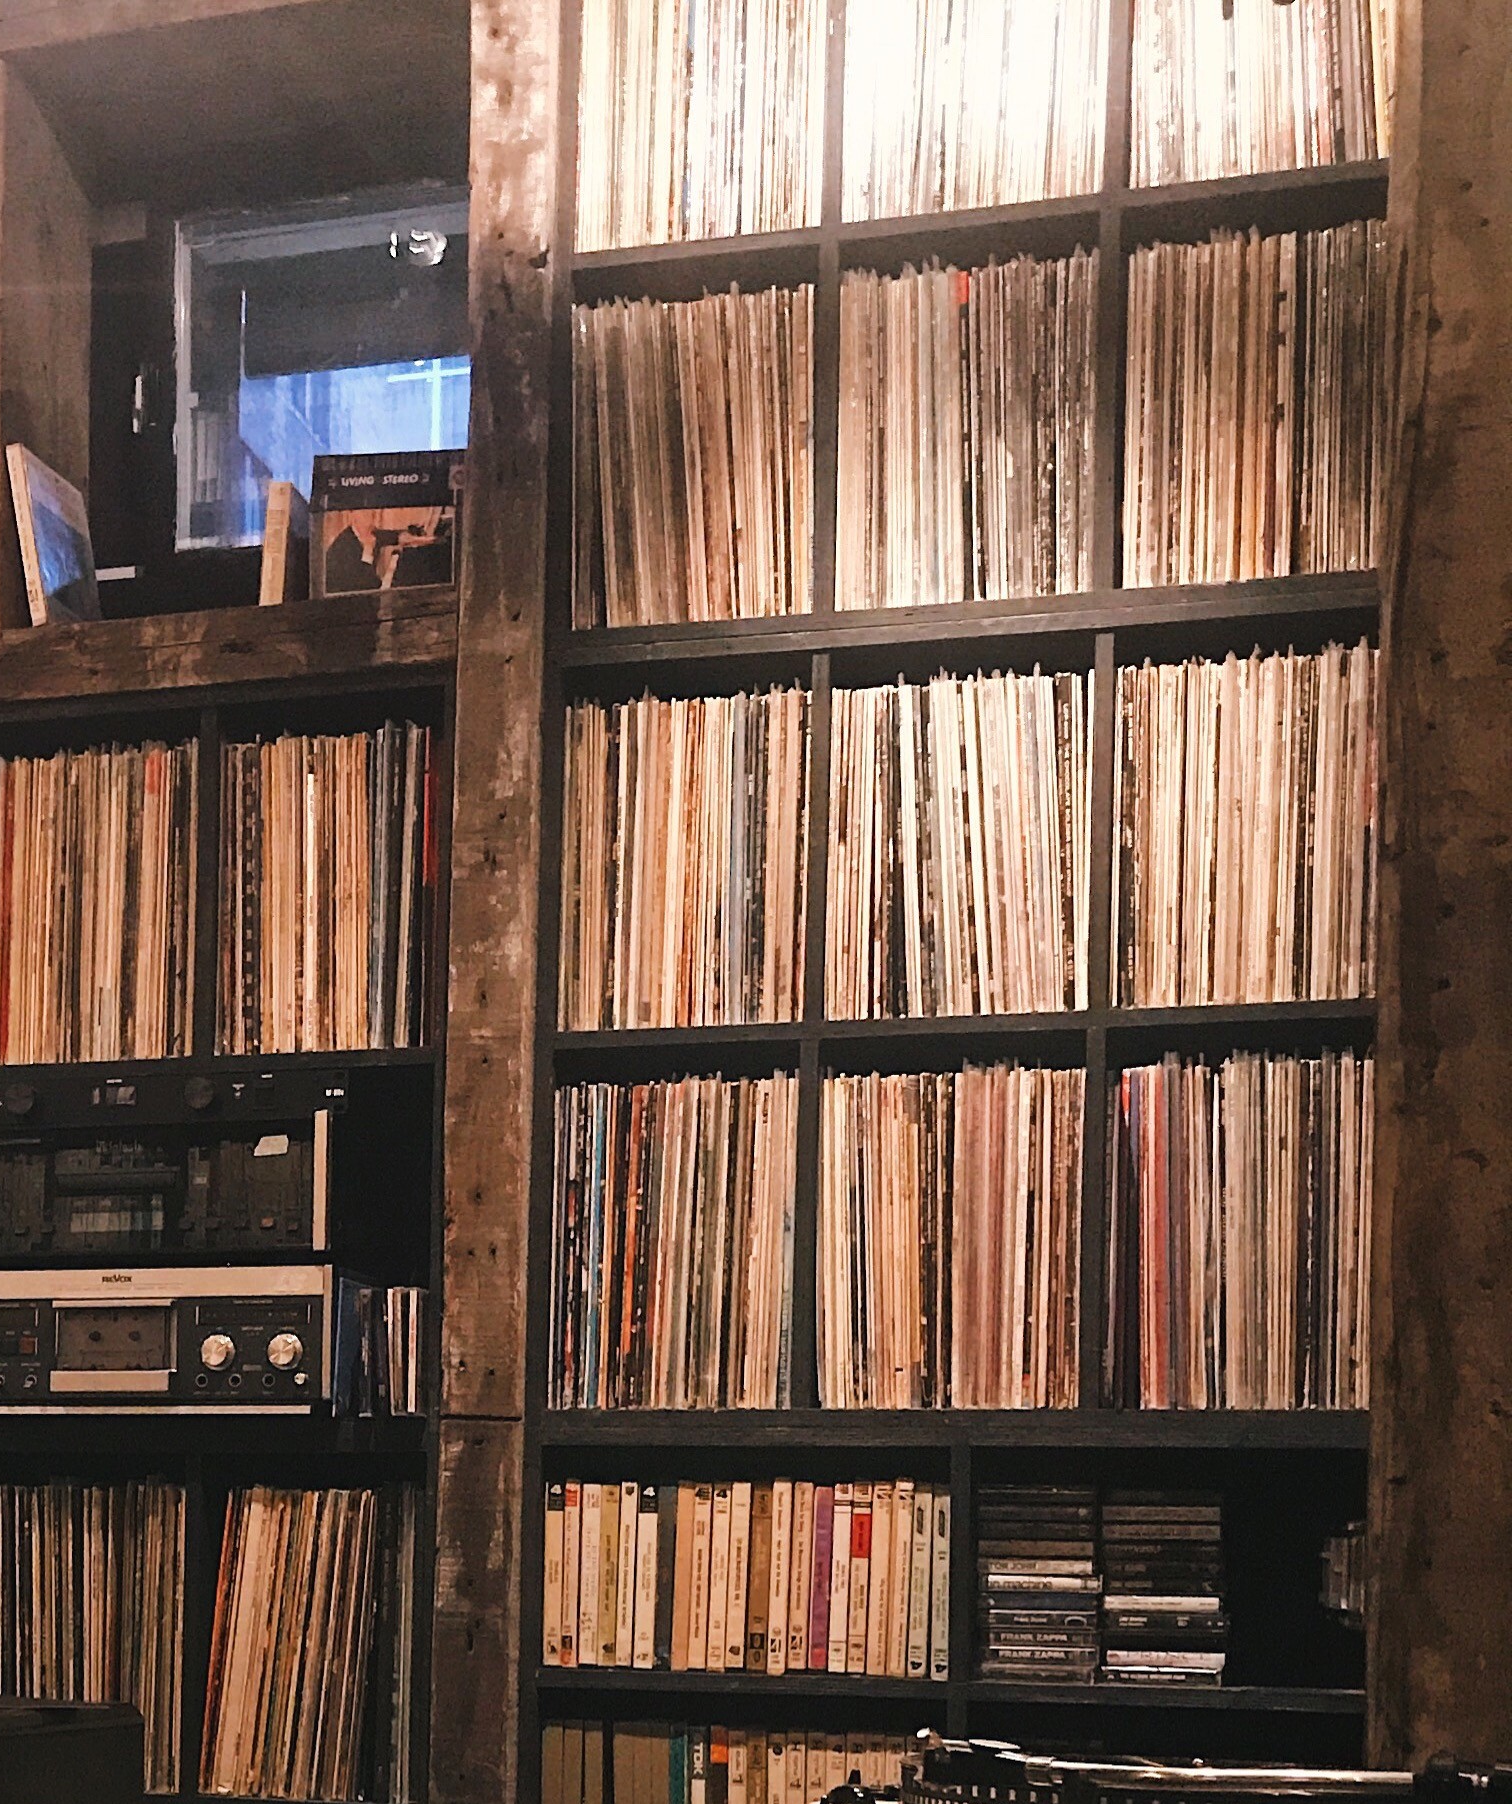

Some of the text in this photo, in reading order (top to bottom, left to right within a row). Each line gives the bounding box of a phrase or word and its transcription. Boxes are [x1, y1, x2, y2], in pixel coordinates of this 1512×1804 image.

[341, 473, 419, 487] LIVING STEREO
[1000, 1633, 1068, 1642] FRANK ZAPPA
[998, 1650, 1066, 1659] FRANK ZAPPA
[693, 1741, 705, 1775] TDK
